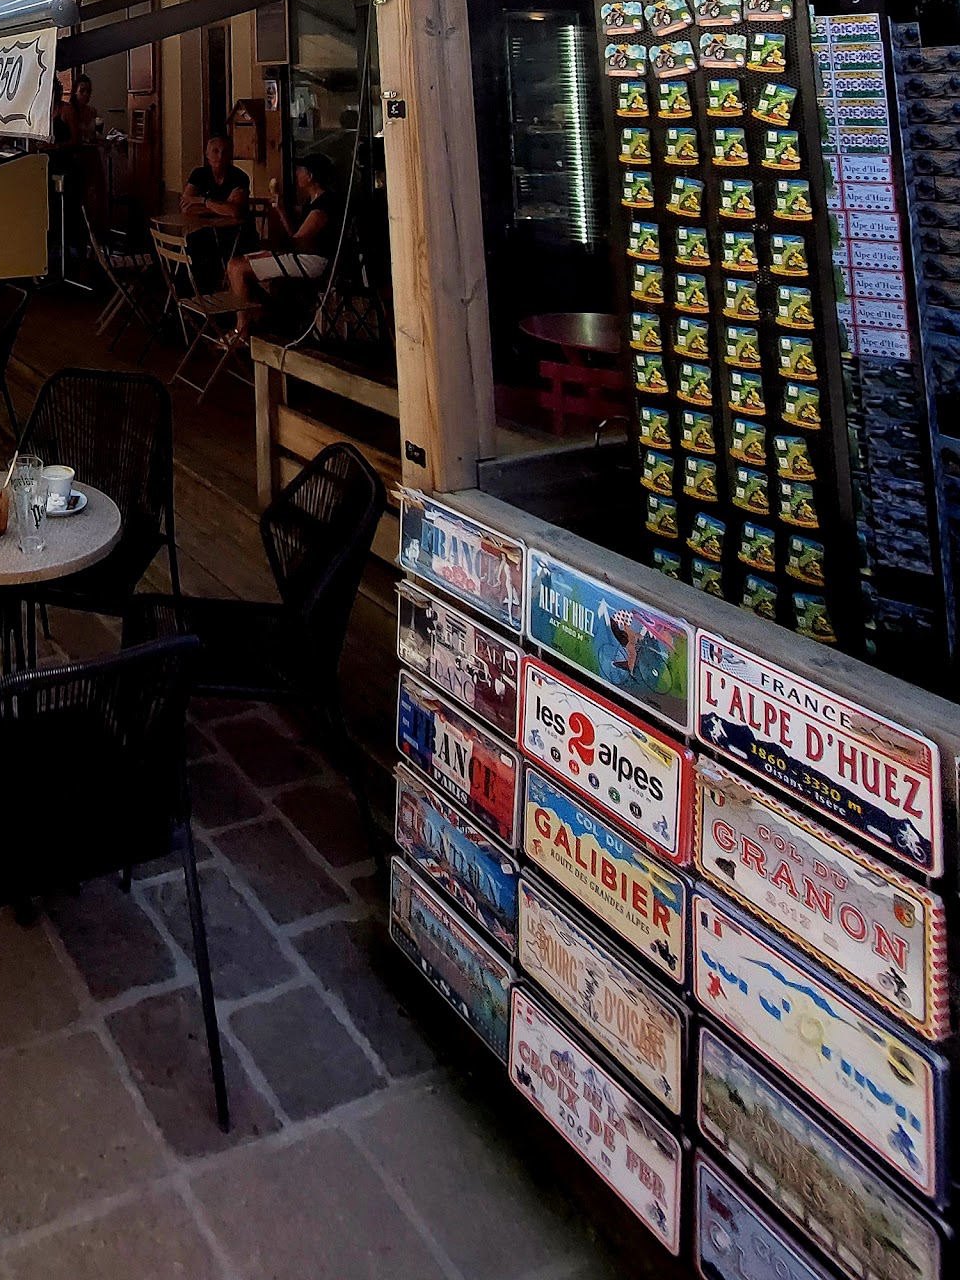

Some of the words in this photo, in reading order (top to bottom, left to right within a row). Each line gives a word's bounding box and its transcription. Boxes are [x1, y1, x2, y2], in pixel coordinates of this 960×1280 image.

[843, 165, 860, 173] Alpe
[862, 165, 889, 173] d'Huez
[846, 193, 862, 202] Alpe
[865, 194, 892, 202] d'Huez
[851, 222, 867, 230] Alpe
[870, 222, 898, 231] d'Huez
[853, 251, 871, 260] Alpe
[873, 251, 900, 260] d'Huez
[856, 280, 872, 288] Alpe
[874, 281, 902, 290] d'Huez
[858, 309, 875, 318] Alpe
[876, 310, 904, 319] d'Huez
[861, 338, 878, 347] Alpe
[880, 339, 908, 349] d'Huez
[539, 583, 561, 619] ALPE
[563, 596, 595, 638] D'HUEZ
[474, 632, 515, 676] PARIS
[760, 671, 852, 730] FRANCE
[536, 695, 566, 736] les
[568, 711, 596, 766] 2
[598, 742, 664, 801] alpes
[705, 670, 793, 749] L'ALPE
[805, 722, 923, 819] D'HUEZ
[433, 767, 469, 805] PARIS
[750, 742, 787, 771] 1860
[802, 772, 841, 801] 3330
[847, 799, 863, 815] m
[764, 763, 803, 792] Oisans
[575, 811, 598, 837] COL
[606, 836, 624, 854] DU
[534, 807, 672, 938] GALIBIER
[757, 823, 804, 866] COL
[813, 858, 849, 892] DU
[550, 848, 574, 873] ROUTE
[574, 868, 589, 885] DES
[589, 881, 624, 915] GRANDES
[625, 911, 651, 936] ALPES
[711, 818, 910, 974] GRANON
[550, 1049, 579, 1089] COL
[518, 1039, 581, 1118] CROIX
[588, 1107, 617, 1153] DE
[625, 1144, 669, 1211] FER
[558, 1104, 593, 1146] 2067
